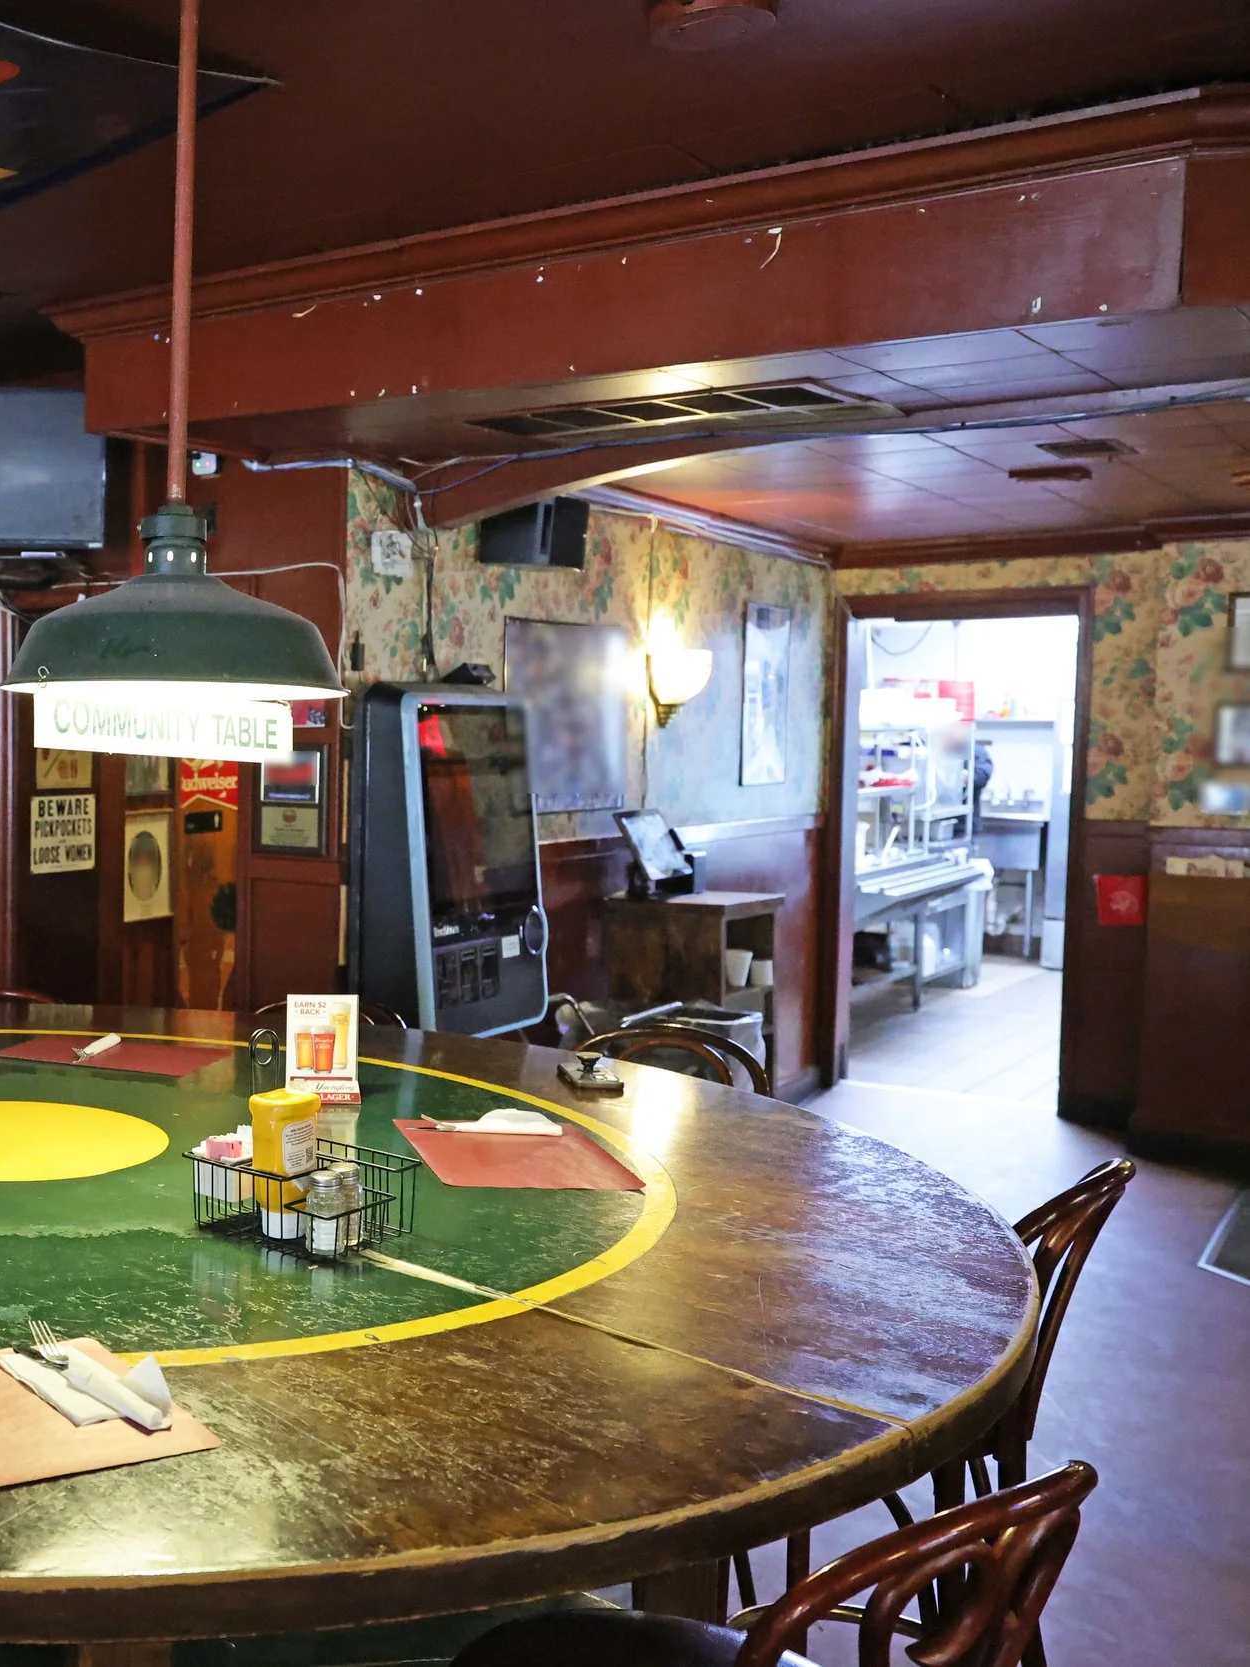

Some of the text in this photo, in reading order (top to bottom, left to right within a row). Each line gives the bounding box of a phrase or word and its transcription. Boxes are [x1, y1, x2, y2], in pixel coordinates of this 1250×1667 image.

[53, 700, 278, 750] COMMUNITY TABLE
[37, 798, 89, 818] BEWARE
[34, 818, 92, 839] PICKPOCKETS
[33, 843, 92, 866] LOOSE WOMEN
[294, 1001, 327, 1009] EARN $2
[300, 1008, 321, 1016] BACK
[319, 1093, 352, 1101] LAGER
